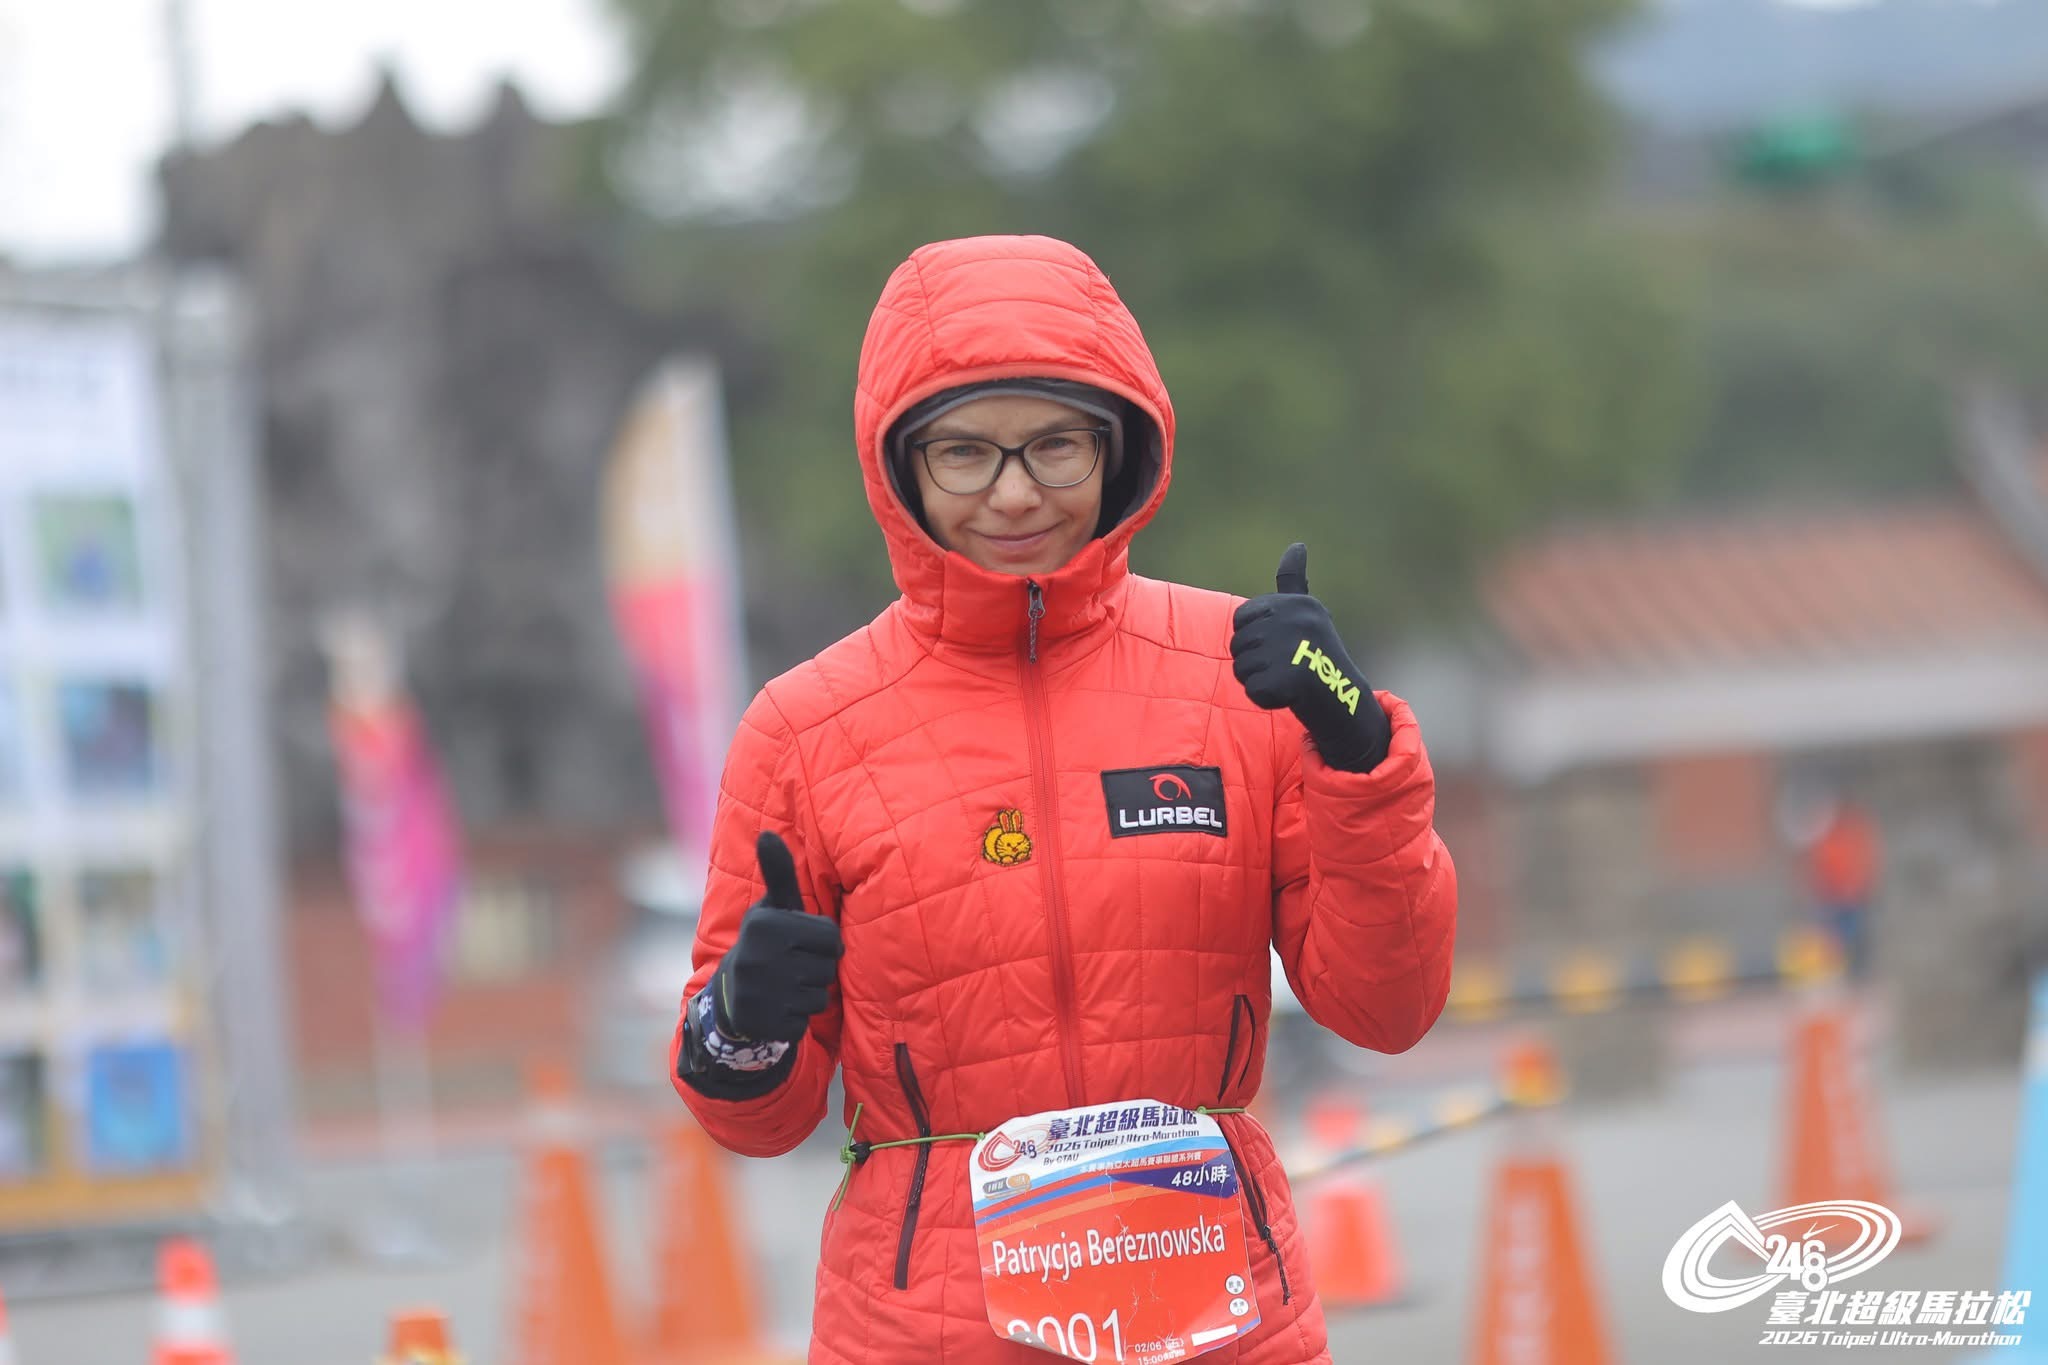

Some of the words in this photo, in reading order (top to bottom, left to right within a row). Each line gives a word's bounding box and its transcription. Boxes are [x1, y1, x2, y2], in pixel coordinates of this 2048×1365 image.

[1291, 639, 1360, 716] HOKA
[1119, 806, 1222, 829] LURBEL
[1045, 1141, 1080, 1154] 2026
[1084, 1136, 1118, 1150] Taipei
[1171, 1165, 1229, 1187] 48小時
[992, 1231, 1082, 1284] Patrycja
[1086, 1215, 1226, 1267] Bereznowska
[1134, 1341, 1162, 1353] 02/06
